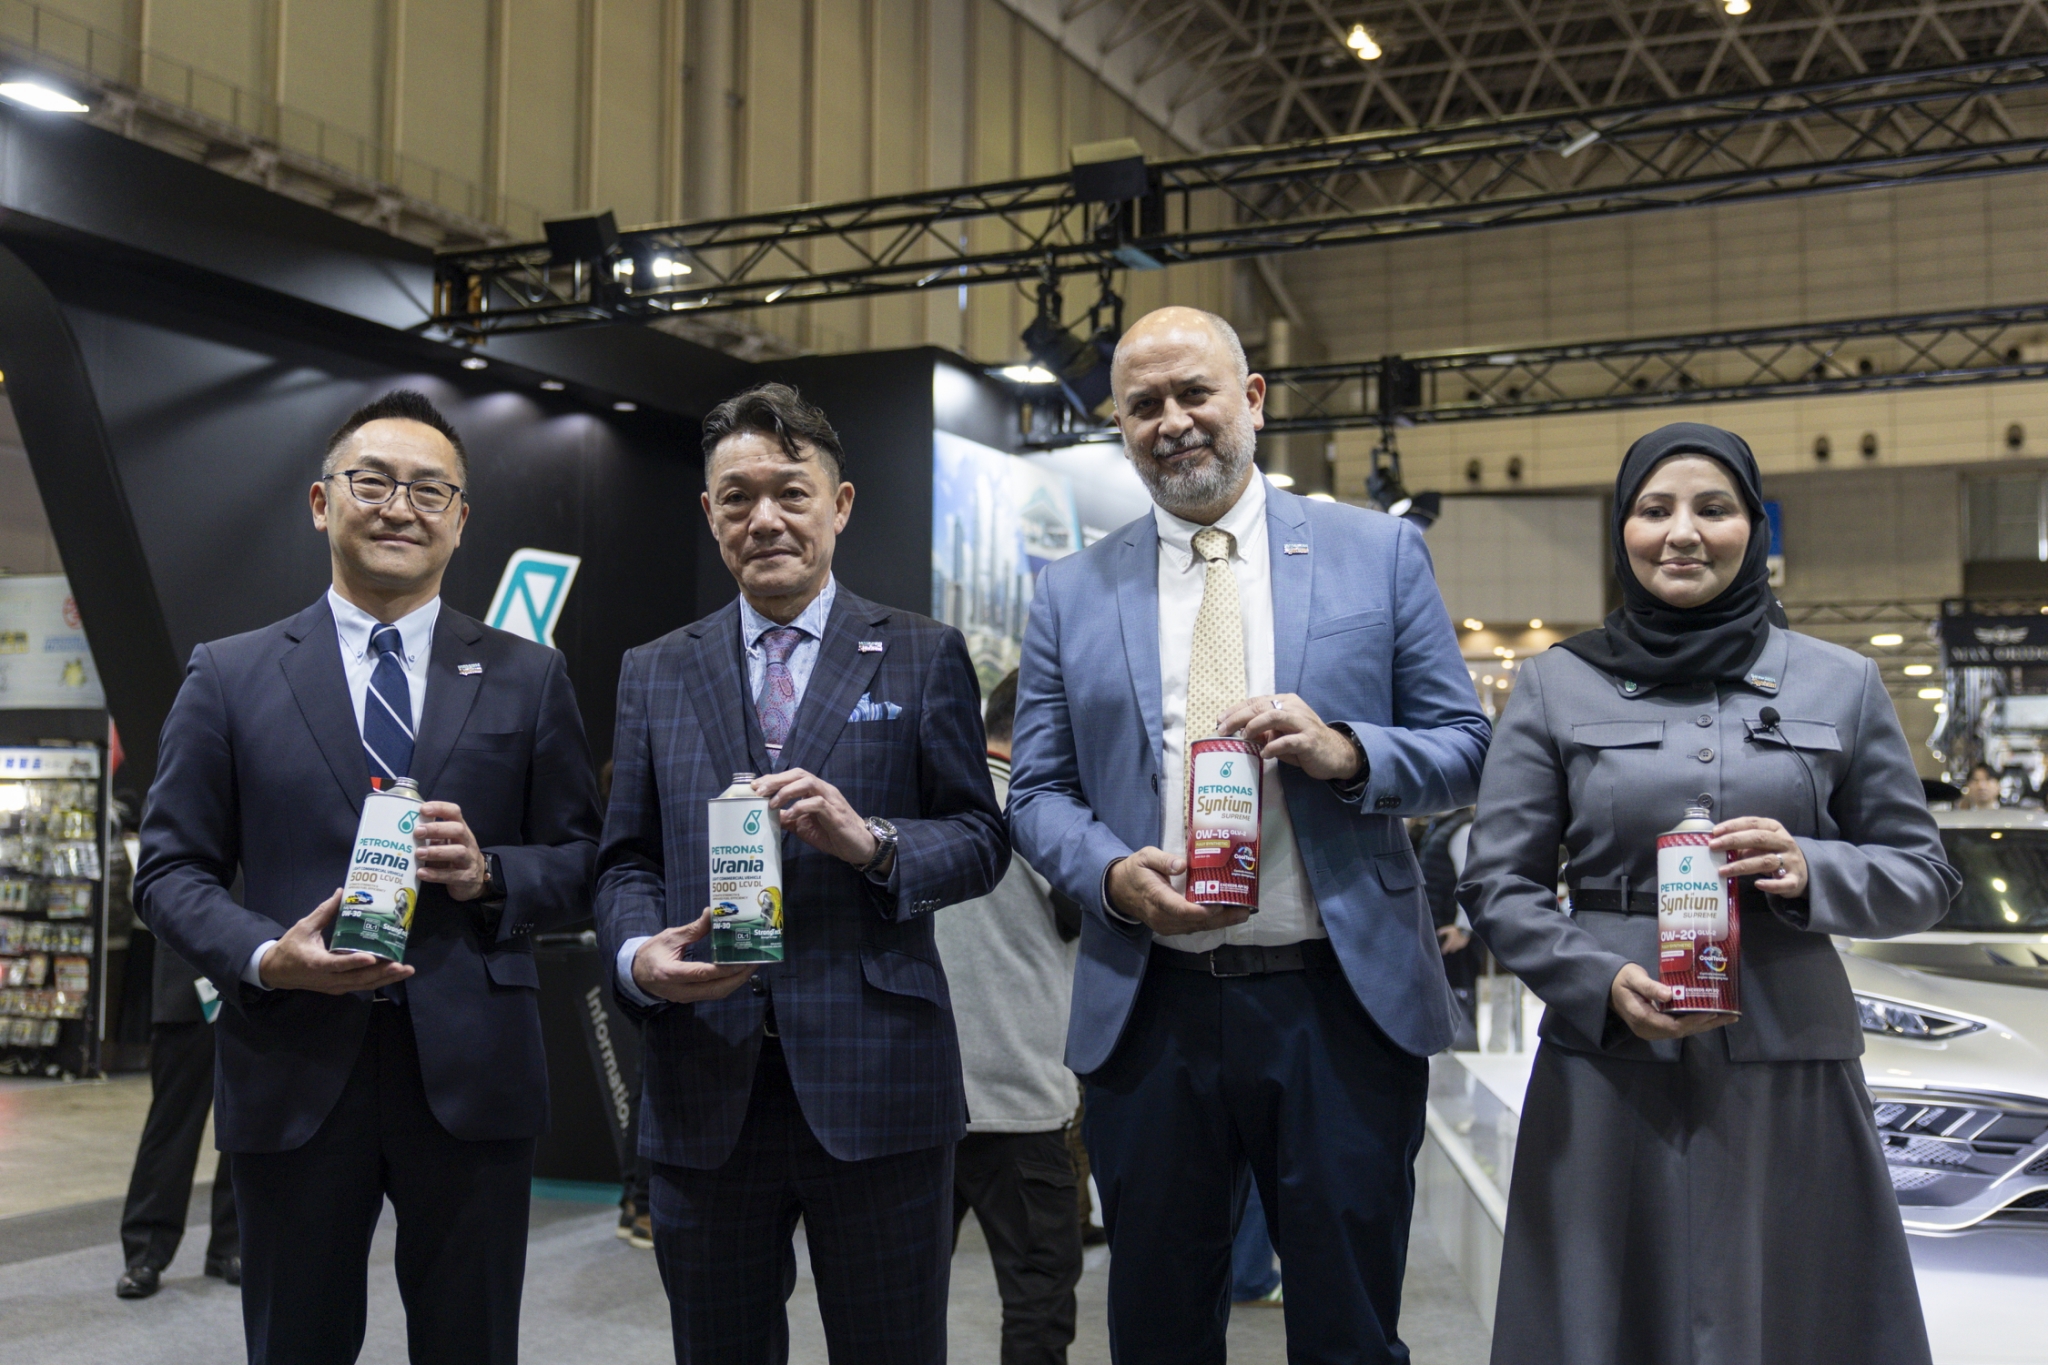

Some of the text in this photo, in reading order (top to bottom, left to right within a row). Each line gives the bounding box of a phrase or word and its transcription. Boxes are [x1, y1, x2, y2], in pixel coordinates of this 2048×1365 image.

[1198, 785, 1253, 796] PETRONAS
[1196, 795, 1252, 815] Syntium
[1221, 813, 1251, 821] SUPREME
[1195, 829, 1230, 840] 0W-16
[359, 838, 413, 854] PETRONAS
[711, 844, 764, 855] PETRONAS
[355, 849, 409, 871] Urania
[711, 855, 764, 874] Urania
[350, 872, 378, 883] 5000
[380, 874, 395, 883] LCV
[712, 882, 738, 893] 5000
[1661, 882, 1718, 893] PETRONAS
[1661, 893, 1719, 915] Syntium
[1661, 930, 1697, 942] 0W-20
